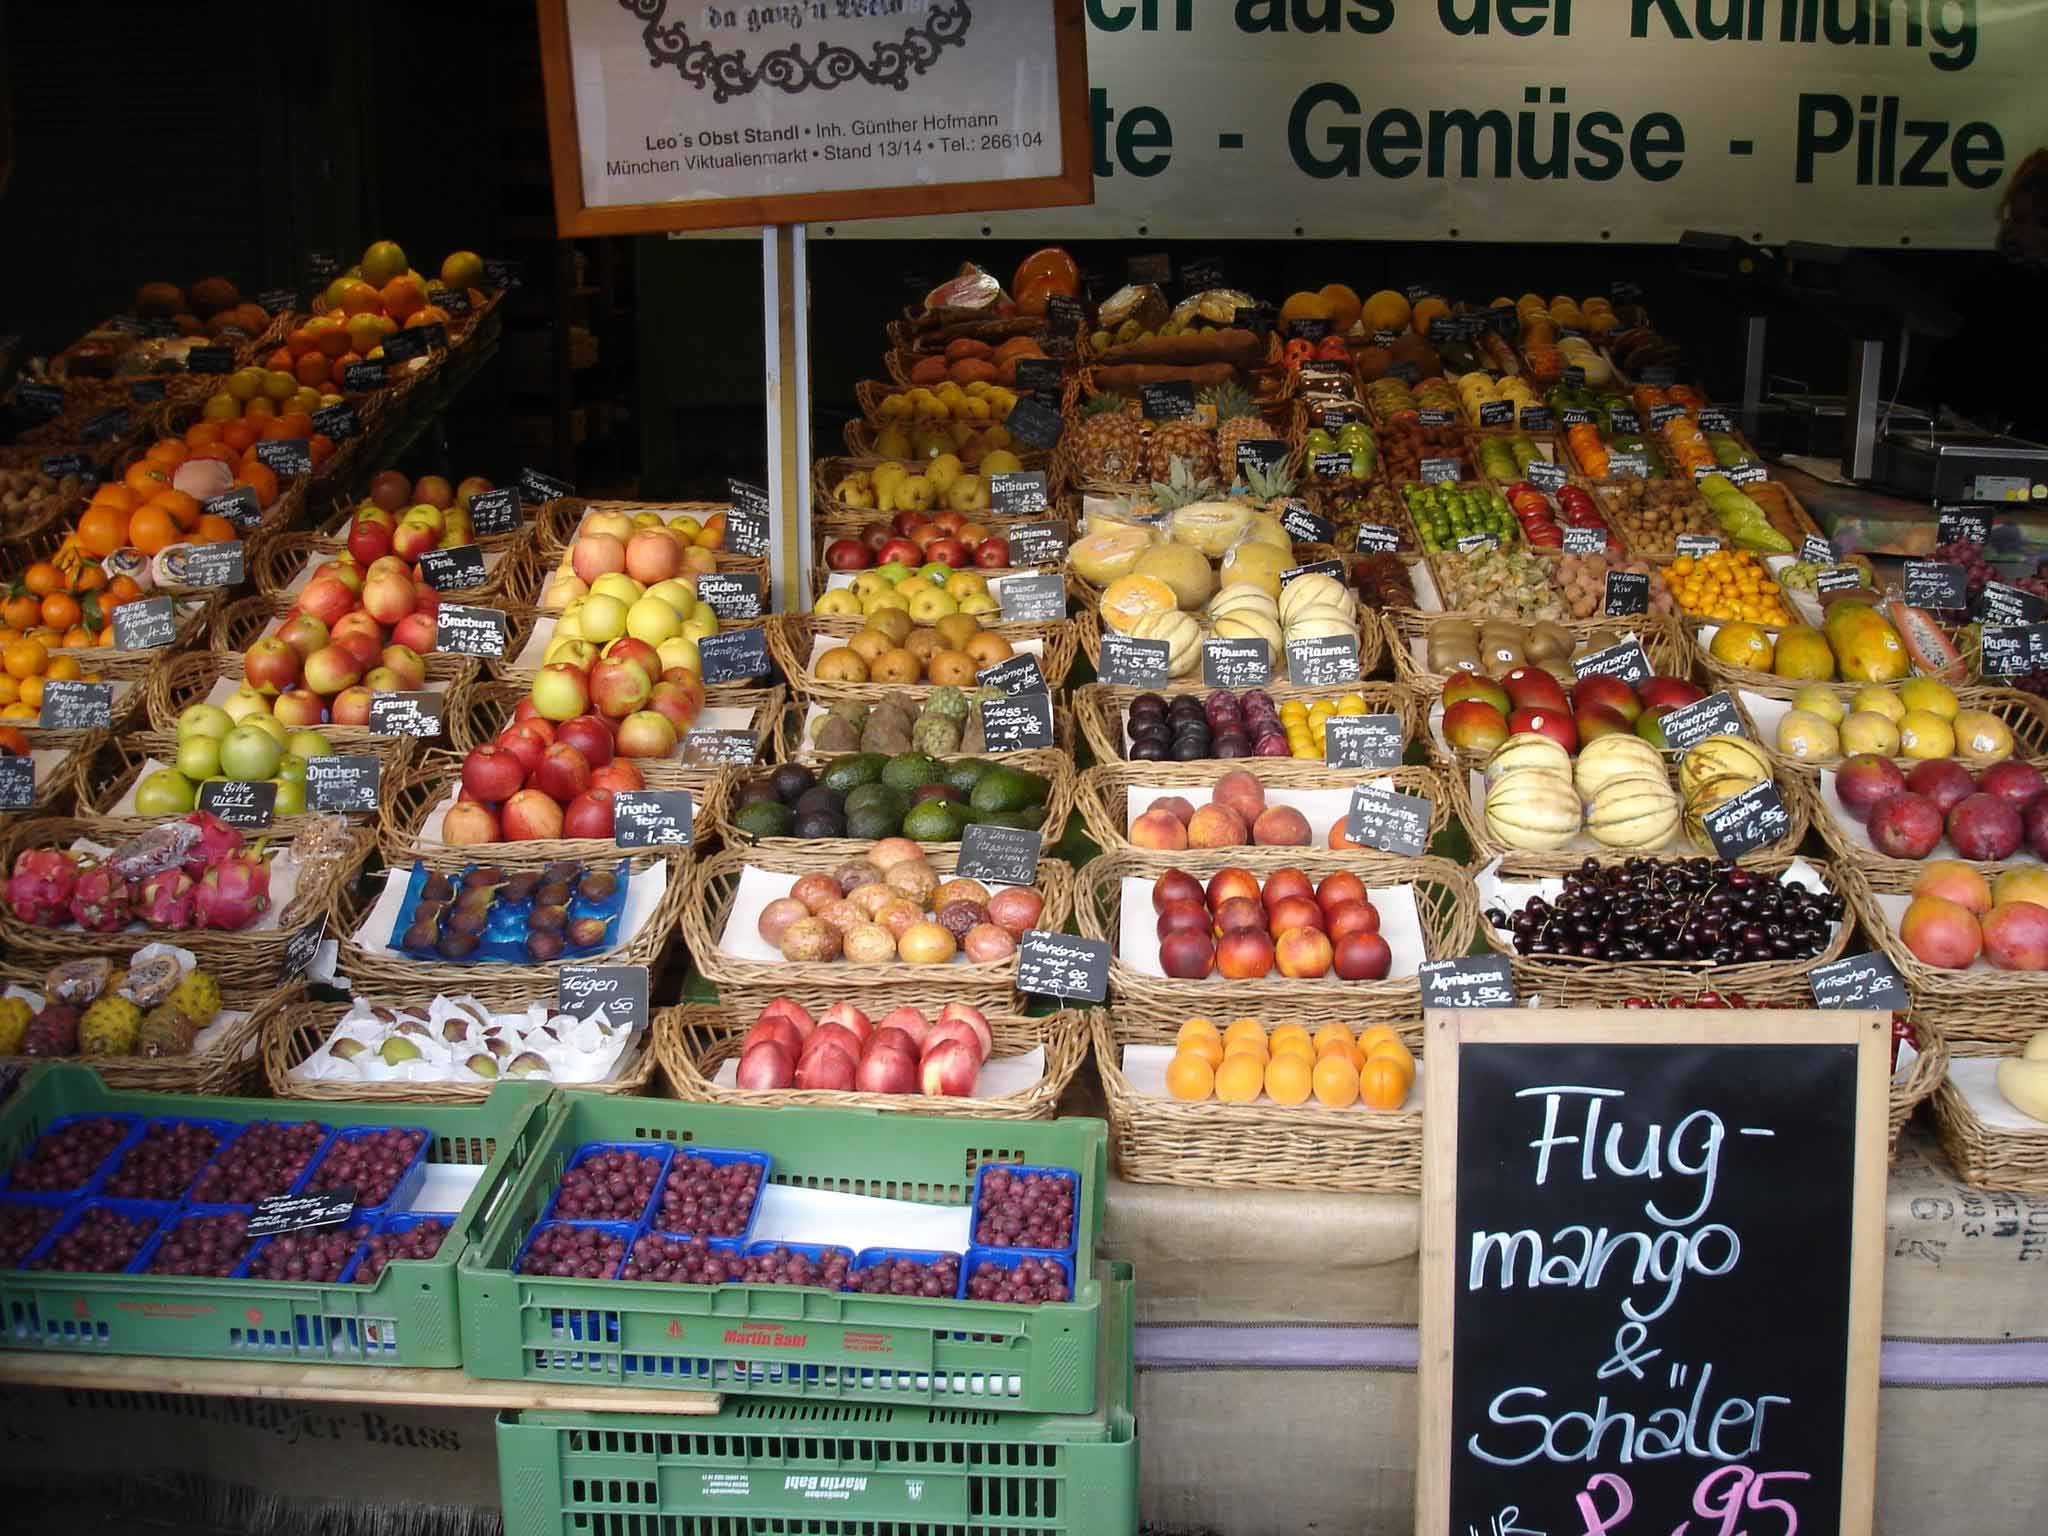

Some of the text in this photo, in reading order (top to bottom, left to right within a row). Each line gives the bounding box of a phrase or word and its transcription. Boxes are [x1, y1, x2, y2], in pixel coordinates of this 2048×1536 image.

[1234, 0, 1396, 34] aus
[698, 128, 741, 148] Obst
[743, 124, 800, 144] Standl
[815, 119, 847, 139] Inh.
[851, 115, 920, 138] Günther
[923, 110, 999, 131] Hofmann
[1286, 81, 1687, 183] Gemüse
[1795, 92, 2006, 190] Pilze
[606, 132, 1043, 177] München Viktualienmarkt Stand 13/14 Tel.: 266104
[728, 517, 761, 539] Fuji
[698, 581, 743, 596] Golden
[211, 791, 256, 808] nicht
[614, 801, 663, 819] frische
[1515, 1085, 1775, 1227] Flug-
[1468, 1223, 1742, 1322] mango
[1596, 1320, 1663, 1379] &
[820, 1476, 868, 1491] Martin
